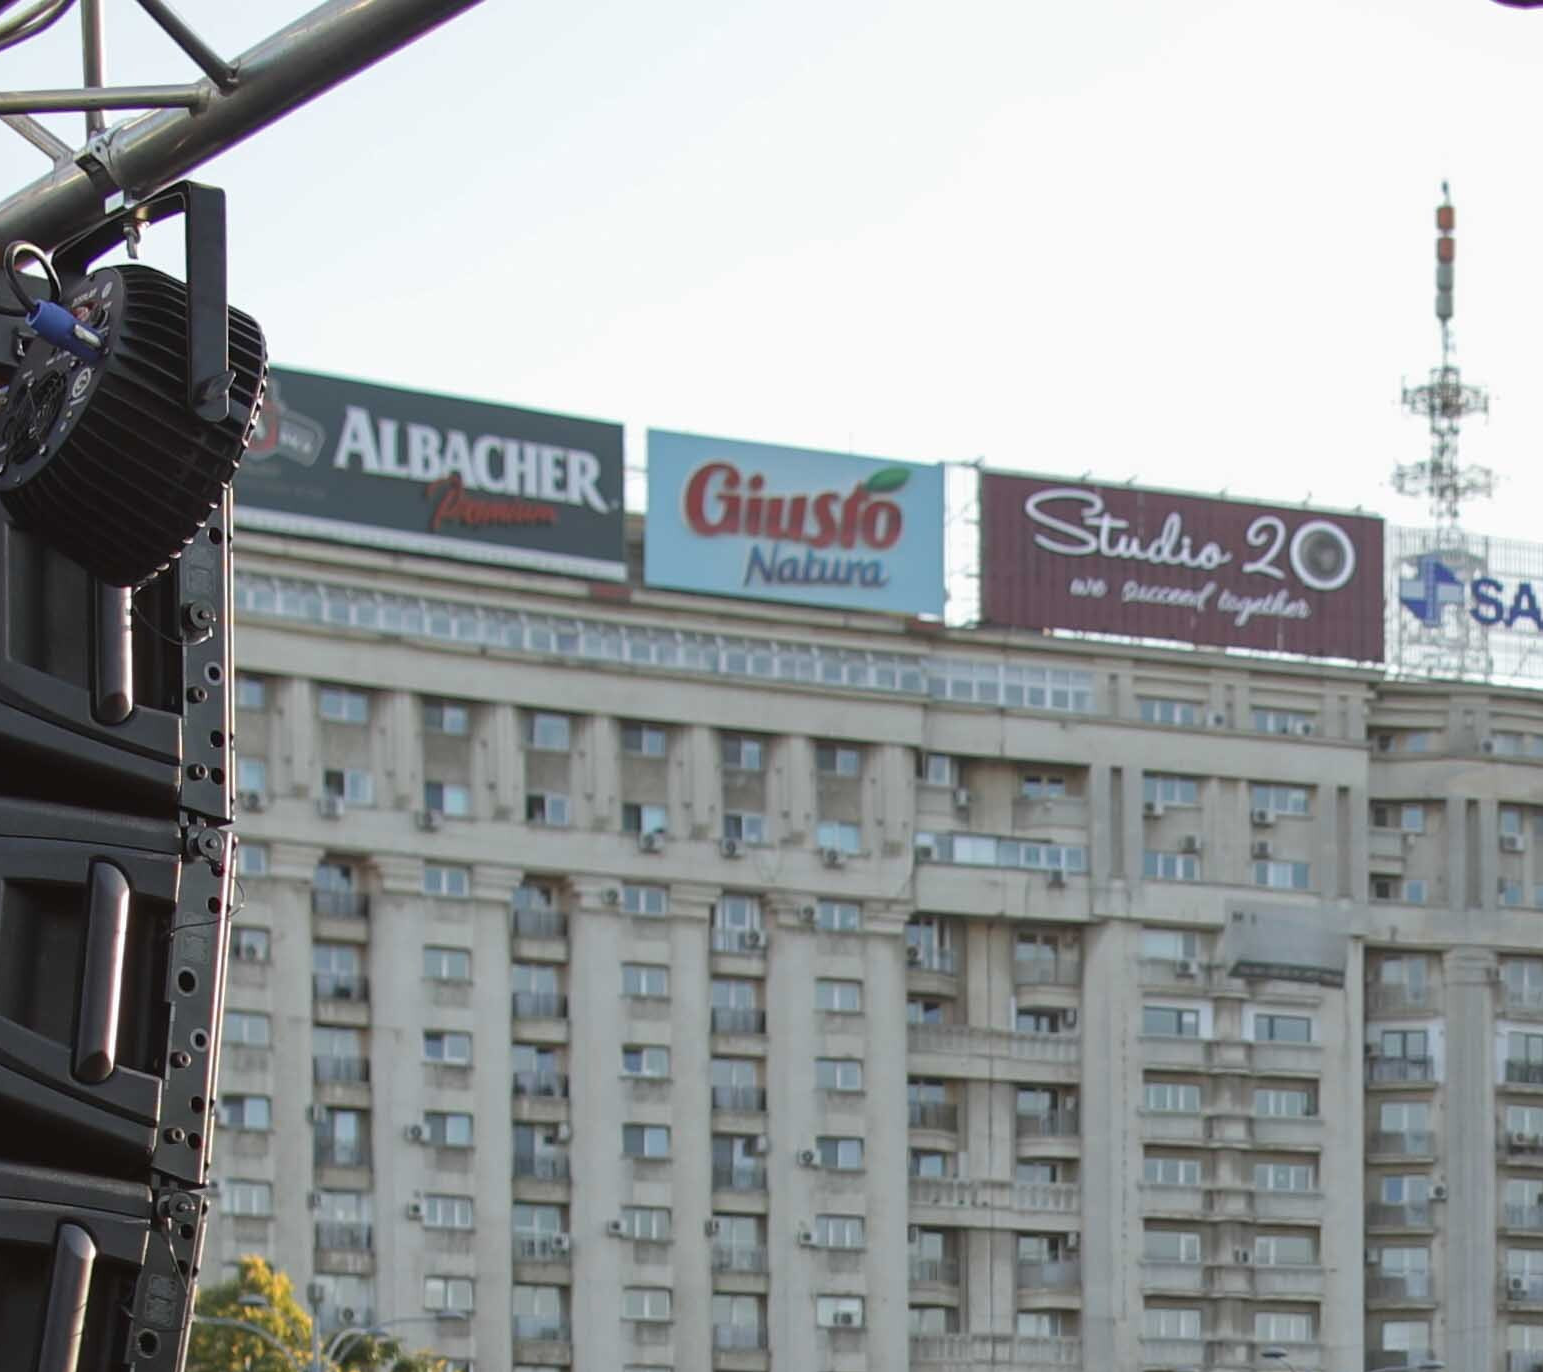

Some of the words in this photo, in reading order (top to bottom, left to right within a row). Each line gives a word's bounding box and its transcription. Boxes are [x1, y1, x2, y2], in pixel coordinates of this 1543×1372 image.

[333, 404, 610, 514] ALBACHER
[683, 461, 903, 551] Giusto
[1024, 488, 1233, 571] Studio
[1242, 515, 1357, 592] 20
[744, 543, 890, 588] Natura
[1217, 588, 1313, 627] together
